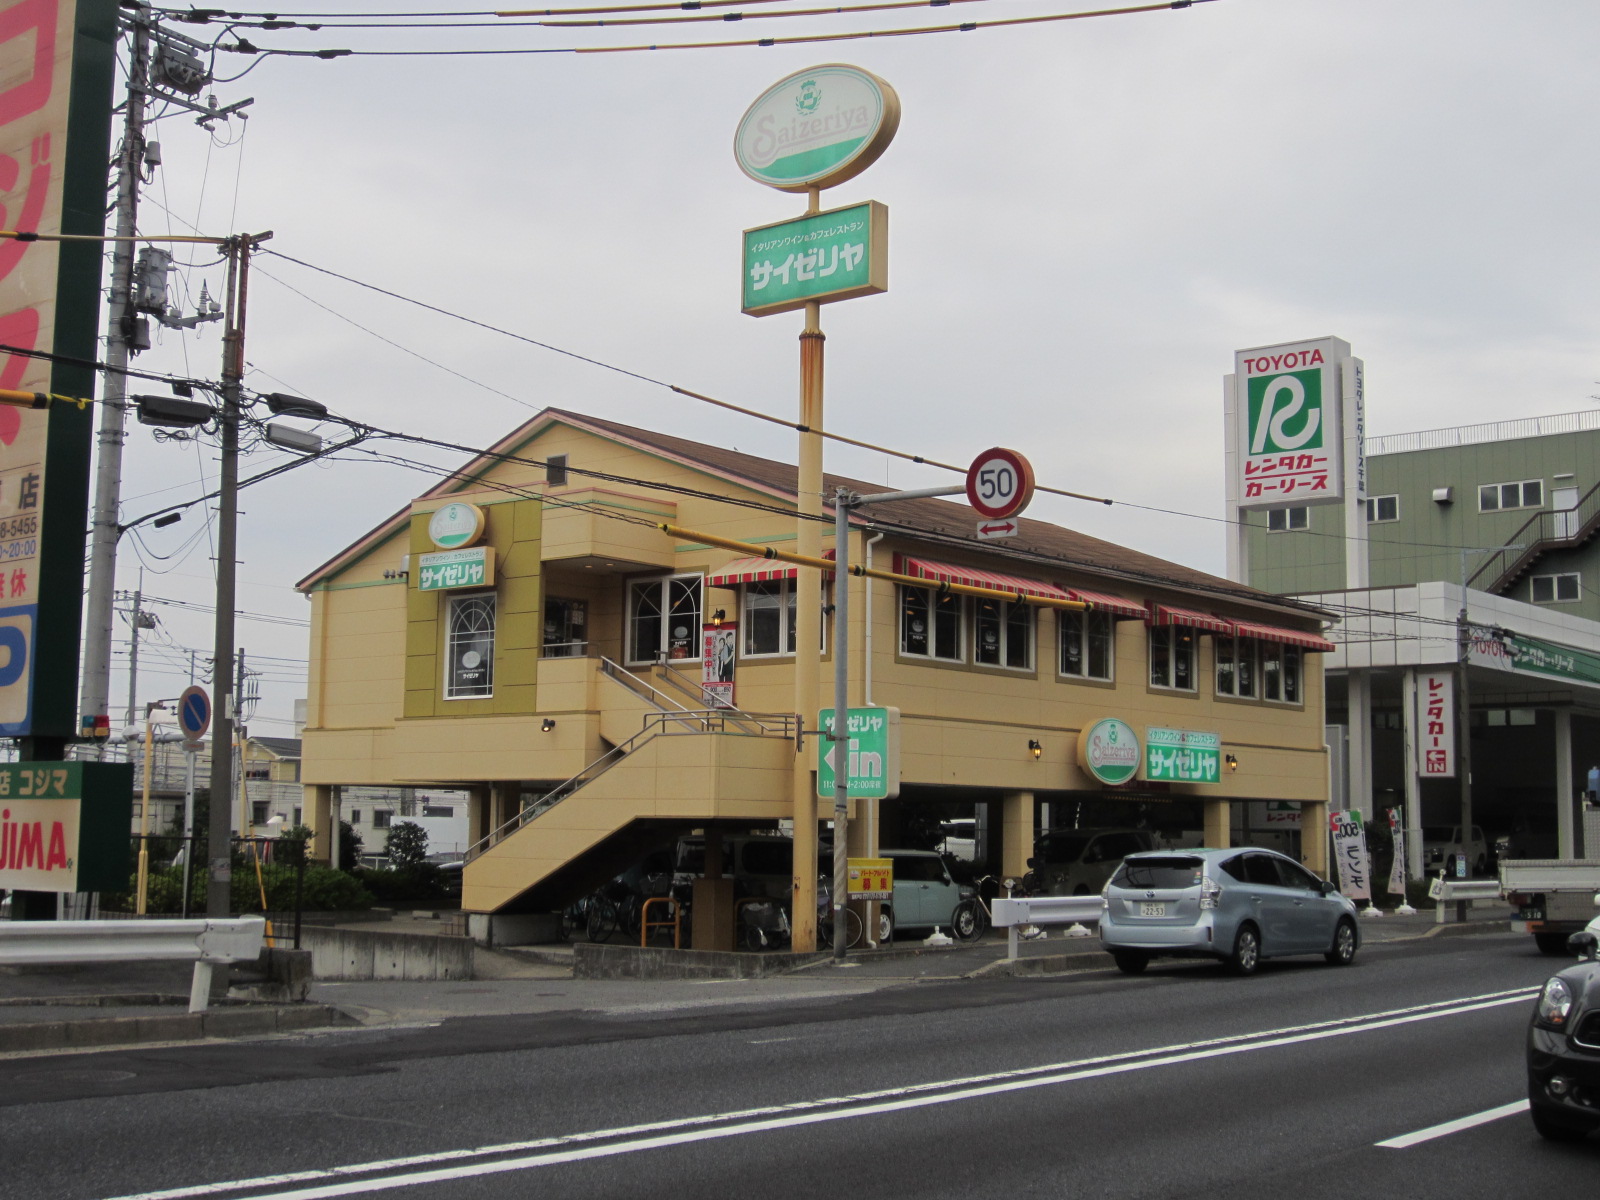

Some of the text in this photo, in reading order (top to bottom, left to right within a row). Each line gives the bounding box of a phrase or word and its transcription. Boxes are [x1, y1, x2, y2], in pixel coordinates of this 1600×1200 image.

[751, 104, 869, 161] Saizeriya
[750, 242, 864, 291] サイゼリヤ
[1243, 349, 1324, 375] TOYOTA
[1245, 453, 1328, 476] レンタカー
[18, 473, 40, 510] 店
[980, 468, 1013, 499] 50
[1245, 474, 1328, 498] カーリース
[421, 563, 484, 589] サイゼリヤ
[825, 715, 883, 732] サゼリヤ
[1427, 678, 1445, 748] レンタカー
[849, 738, 882, 778] in
[1091, 735, 1137, 767] Saizeriya
[1150, 749, 1217, 780] サイゼリヤ
[19, 769, 68, 797] コジマ
[1427, 763, 1446, 774] IN
